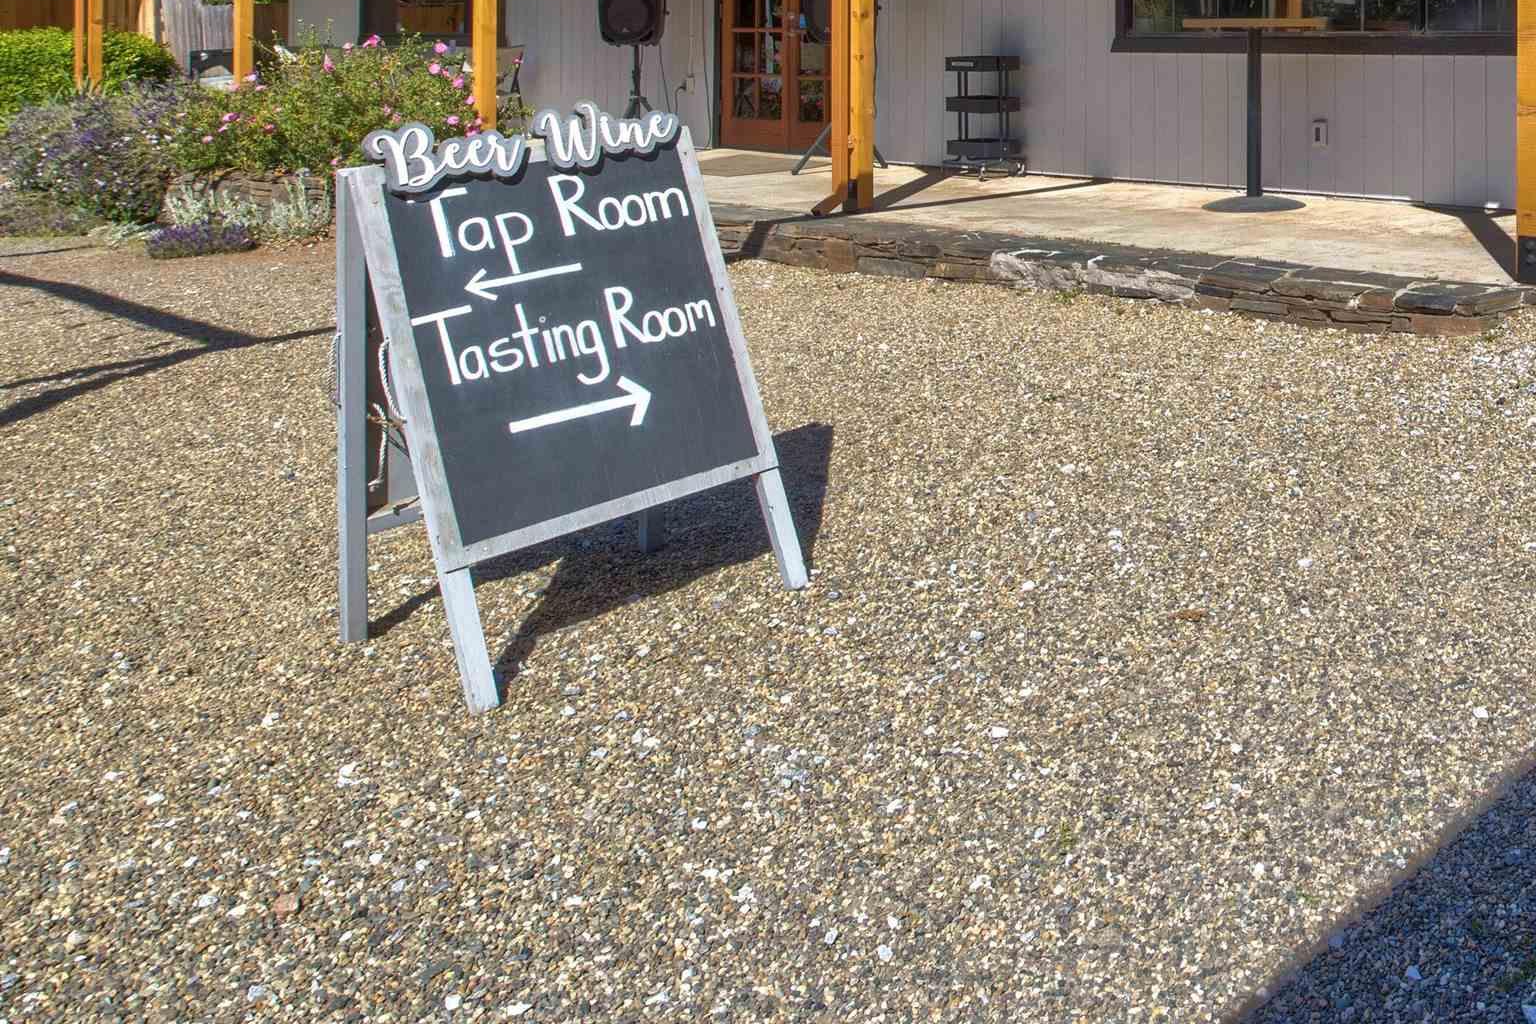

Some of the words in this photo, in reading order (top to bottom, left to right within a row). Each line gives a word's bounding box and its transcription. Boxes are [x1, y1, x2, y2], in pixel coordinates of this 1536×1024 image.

[373, 127, 521, 186] Beer
[540, 104, 674, 163] Wine
[428, 188, 534, 275] Tap
[547, 174, 690, 238] Room
[411, 303, 612, 386] Tasting
[604, 286, 716, 350] Room
